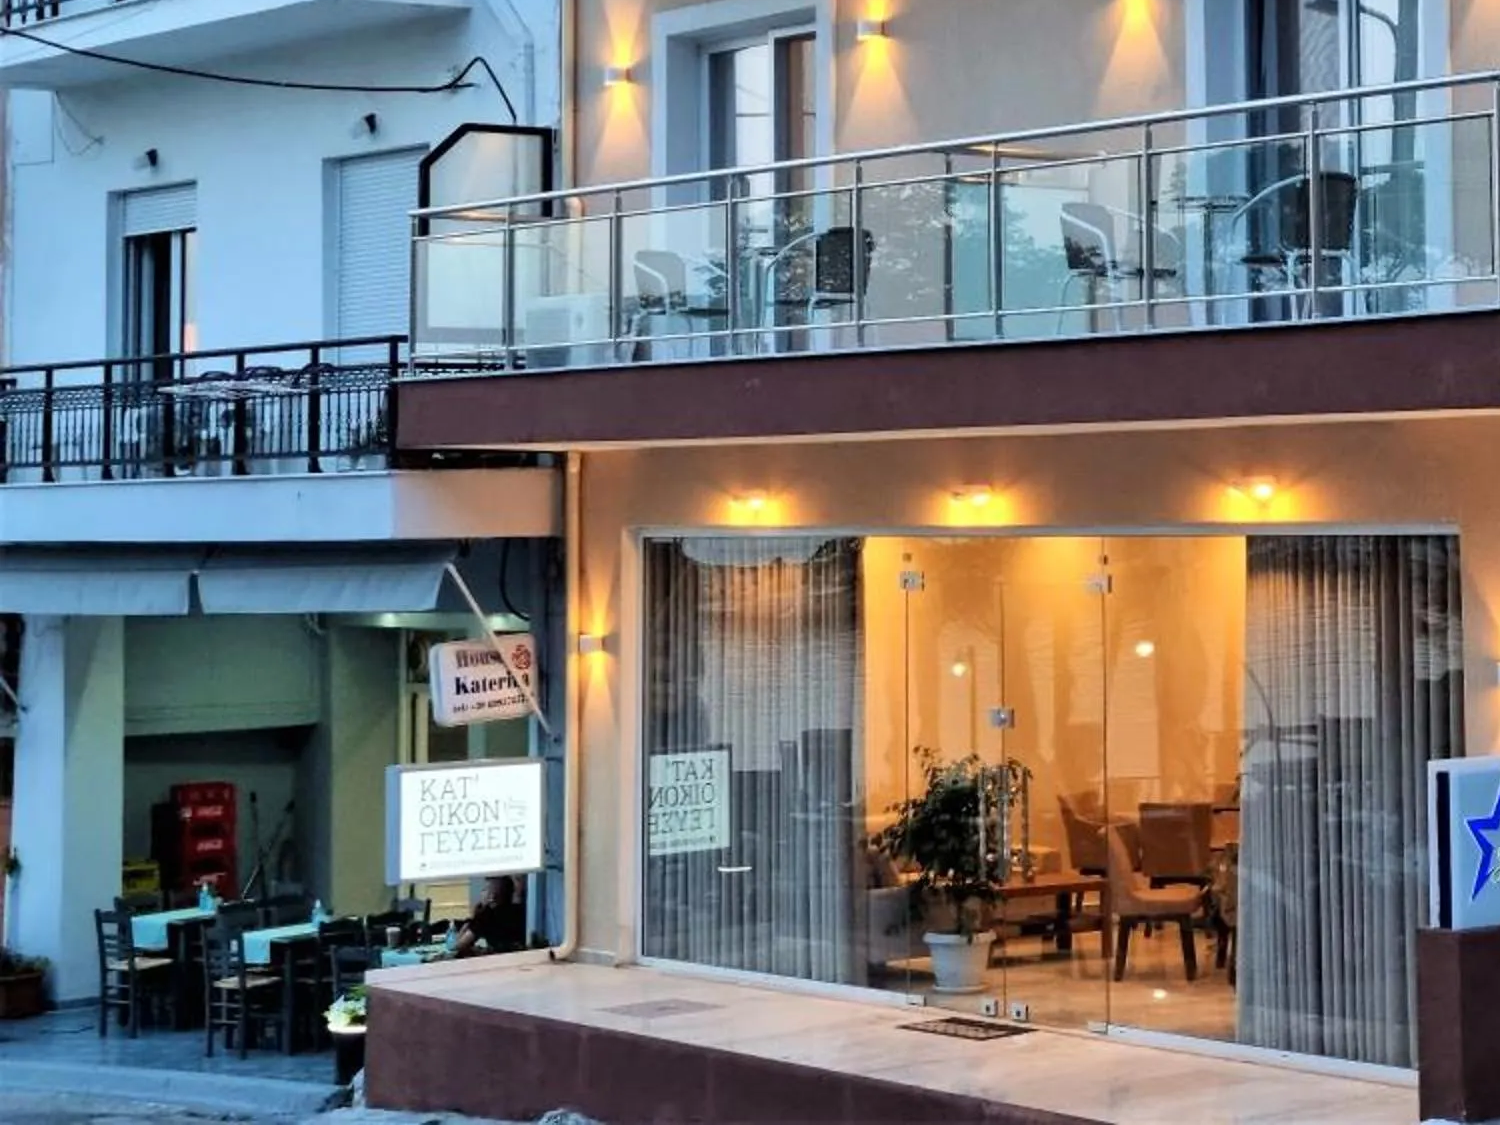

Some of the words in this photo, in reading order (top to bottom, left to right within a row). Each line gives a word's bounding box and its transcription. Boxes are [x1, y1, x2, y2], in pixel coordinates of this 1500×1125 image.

[455, 649, 505, 668] Hous
[419, 799, 500, 828] ΟΙΚΟΝ
[419, 824, 527, 856] ΓΕΥΣΕΙΣ
